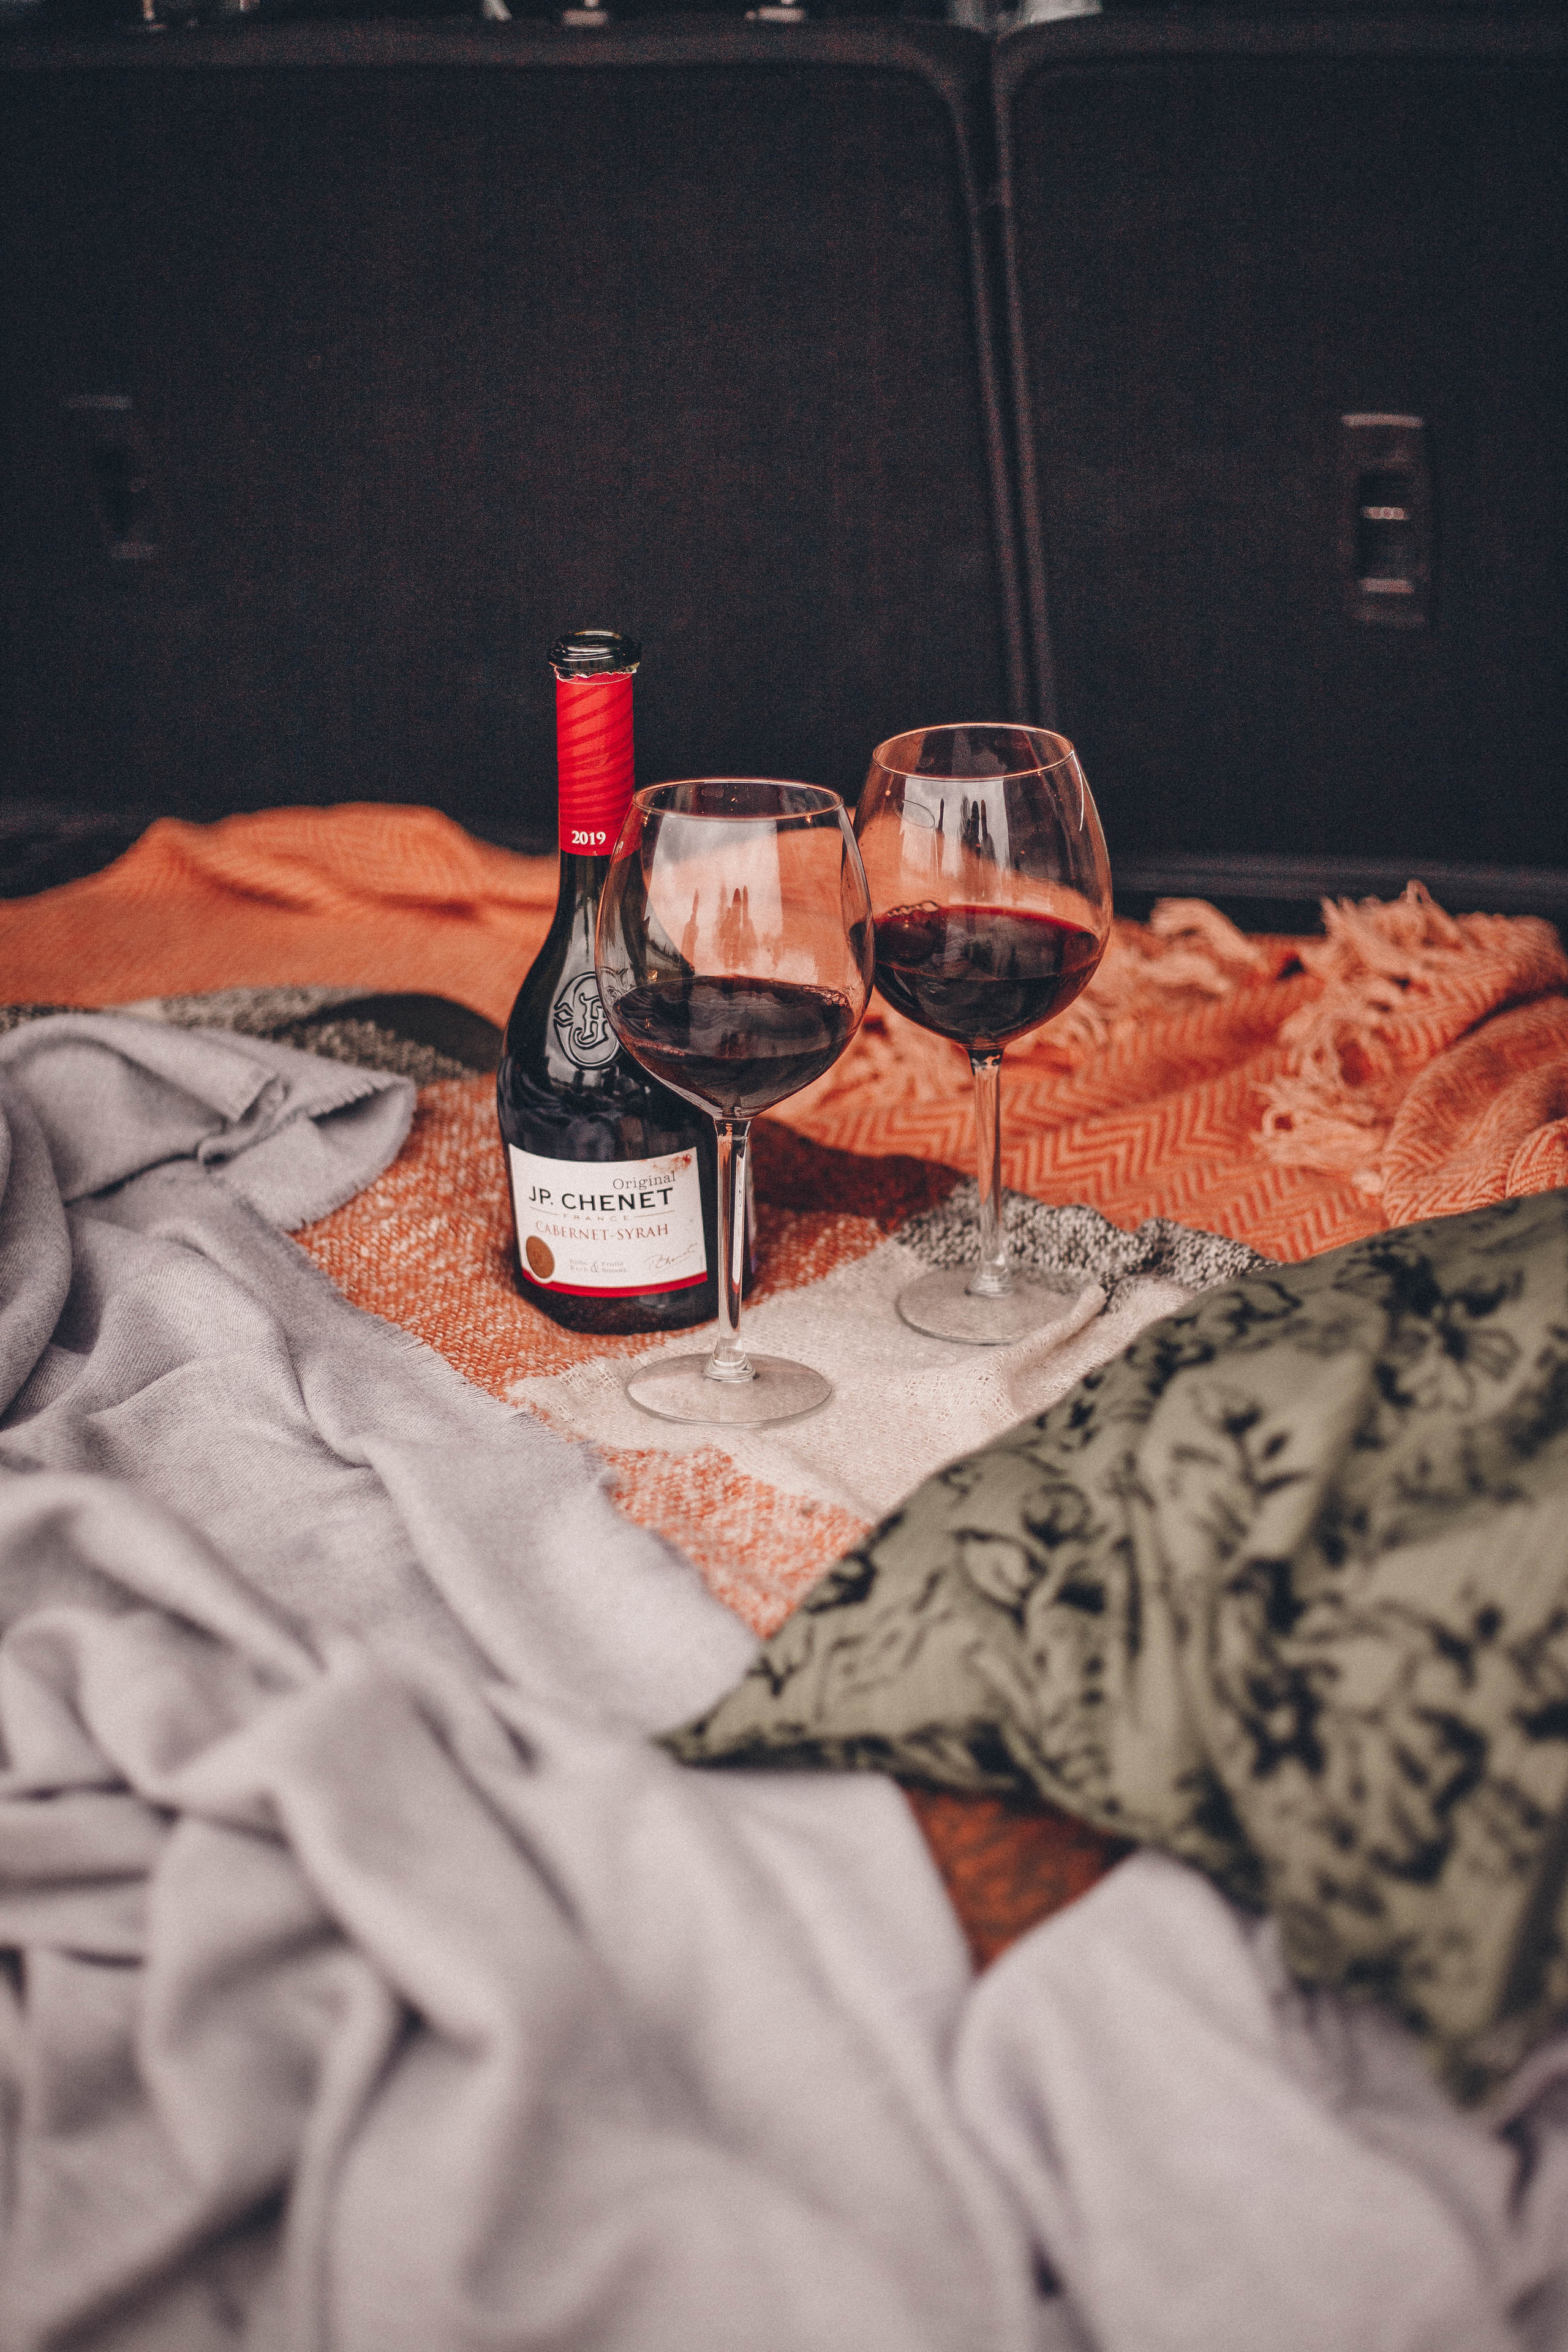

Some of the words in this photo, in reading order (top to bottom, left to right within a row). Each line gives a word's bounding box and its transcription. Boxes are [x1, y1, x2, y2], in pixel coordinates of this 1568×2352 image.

[571, 830, 606, 845] 2019
[612, 1170, 677, 1190] Original
[529, 1186, 554, 1205] JP.
[562, 1187, 674, 1212] CHENET
[535, 1220, 669, 1240] CABERNET-SYRAH
